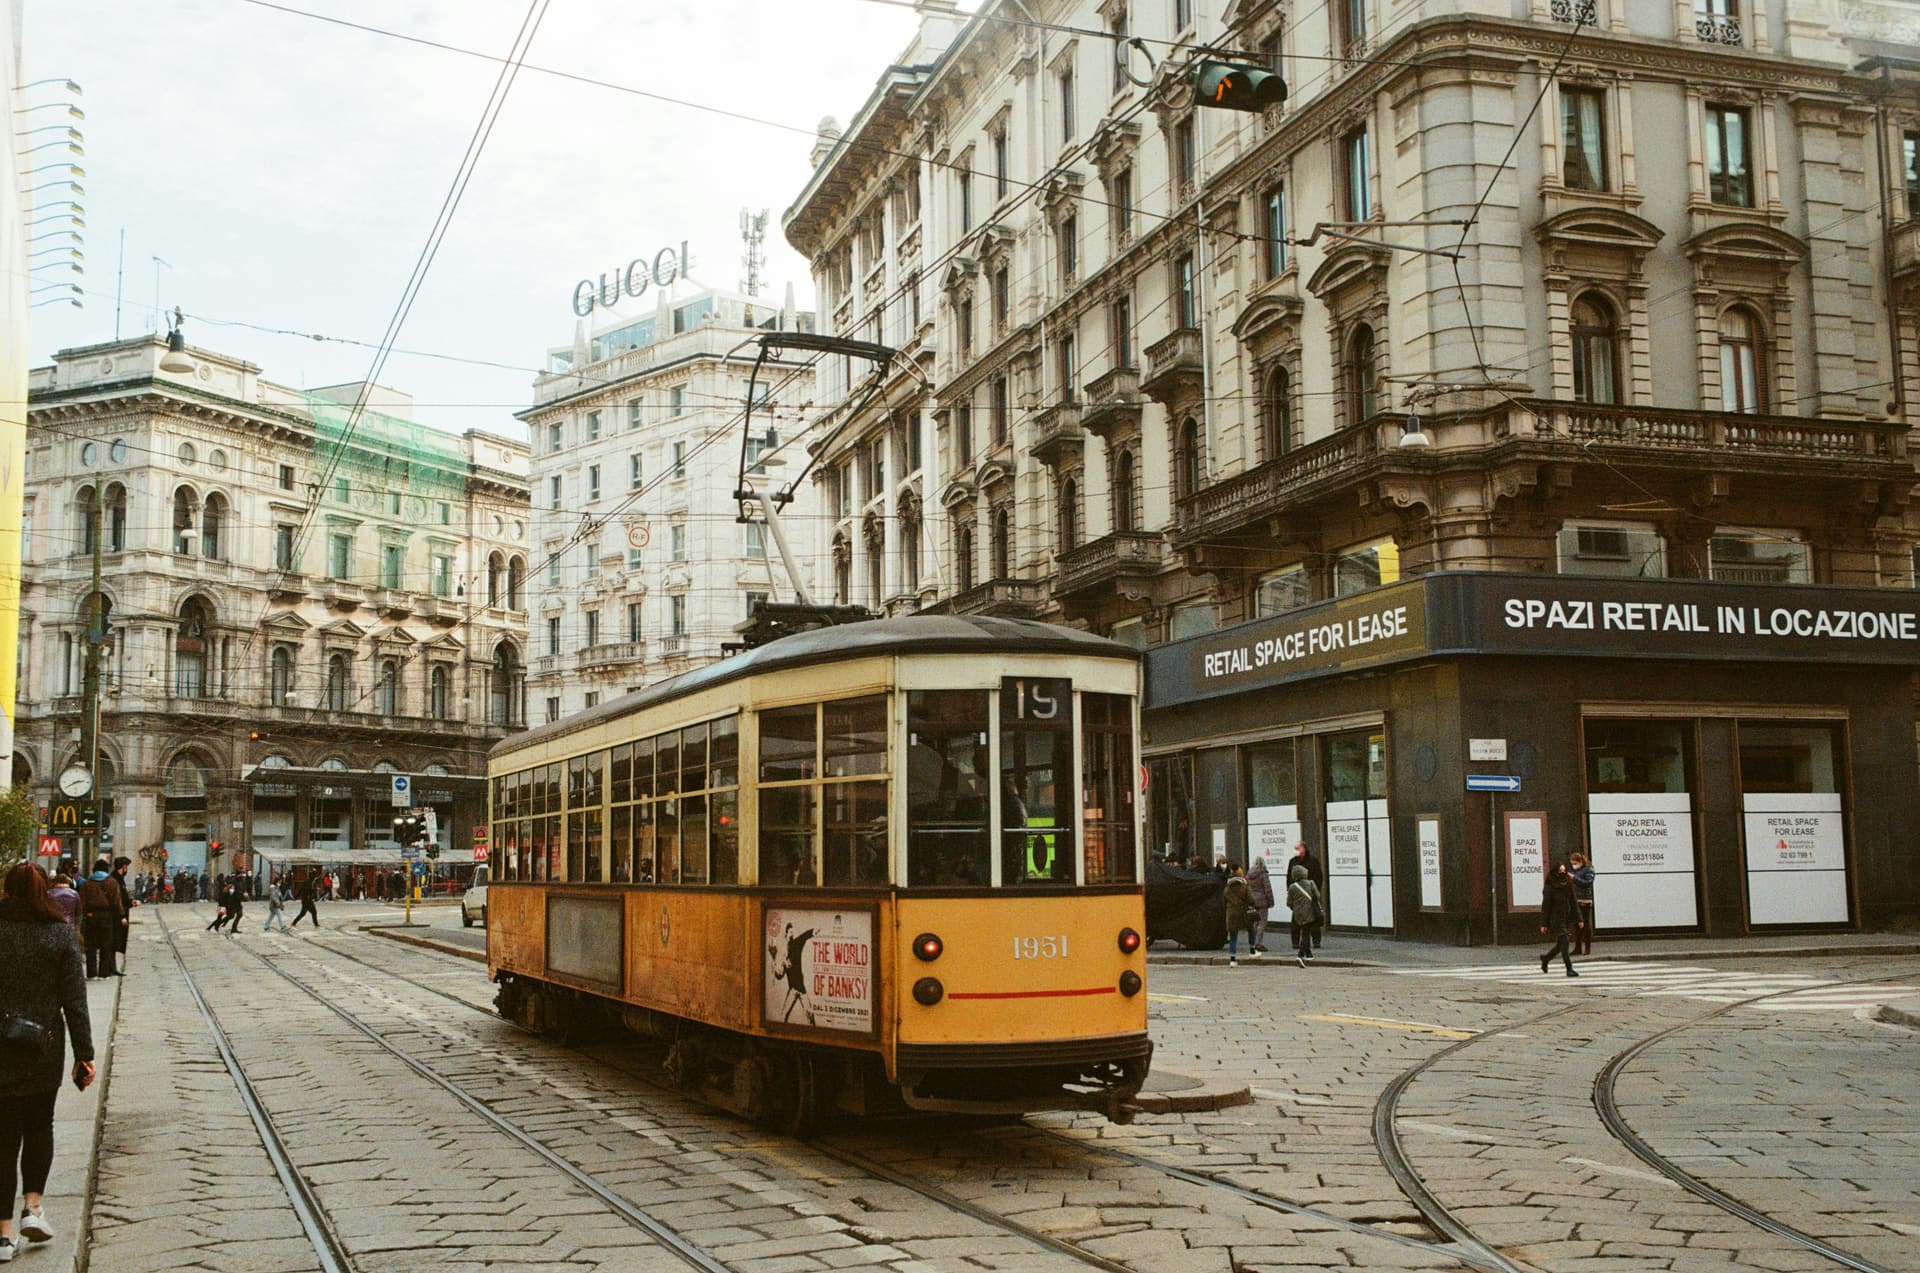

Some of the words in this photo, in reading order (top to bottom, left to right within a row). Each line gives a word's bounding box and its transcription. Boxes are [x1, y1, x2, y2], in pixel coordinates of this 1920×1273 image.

[573, 240, 688, 317] GUCCI
[1504, 599, 1594, 629] SPAZI
[1603, 602, 1710, 632] RETAIL
[1717, 606, 1745, 634] IN
[1754, 608, 1918, 639] LOCAZIONE
[1205, 647, 1253, 677] RETAIL
[1255, 632, 1305, 667] SPACE
[1309, 623, 1344, 654] FOR
[1348, 606, 1408, 647] LEASE
[1617, 819, 1640, 827] SPAZI
[1641, 819, 1667, 827] RETAIL
[1625, 829, 1669, 837] LOCAZIONE
[1768, 818, 1793, 826] RETAIL
[1795, 818, 1820, 826] SPACE
[1775, 828, 1790, 836] FOR
[1792, 828, 1816, 836] LEASE
[1516, 838, 1537, 846] SPAZI
[812, 941, 830, 963] THE
[834, 942, 868, 966] WORLD
[1013, 935, 1068, 960] 1951
[814, 974, 825, 996] OF
[828, 975, 868, 1001] BANKSY
